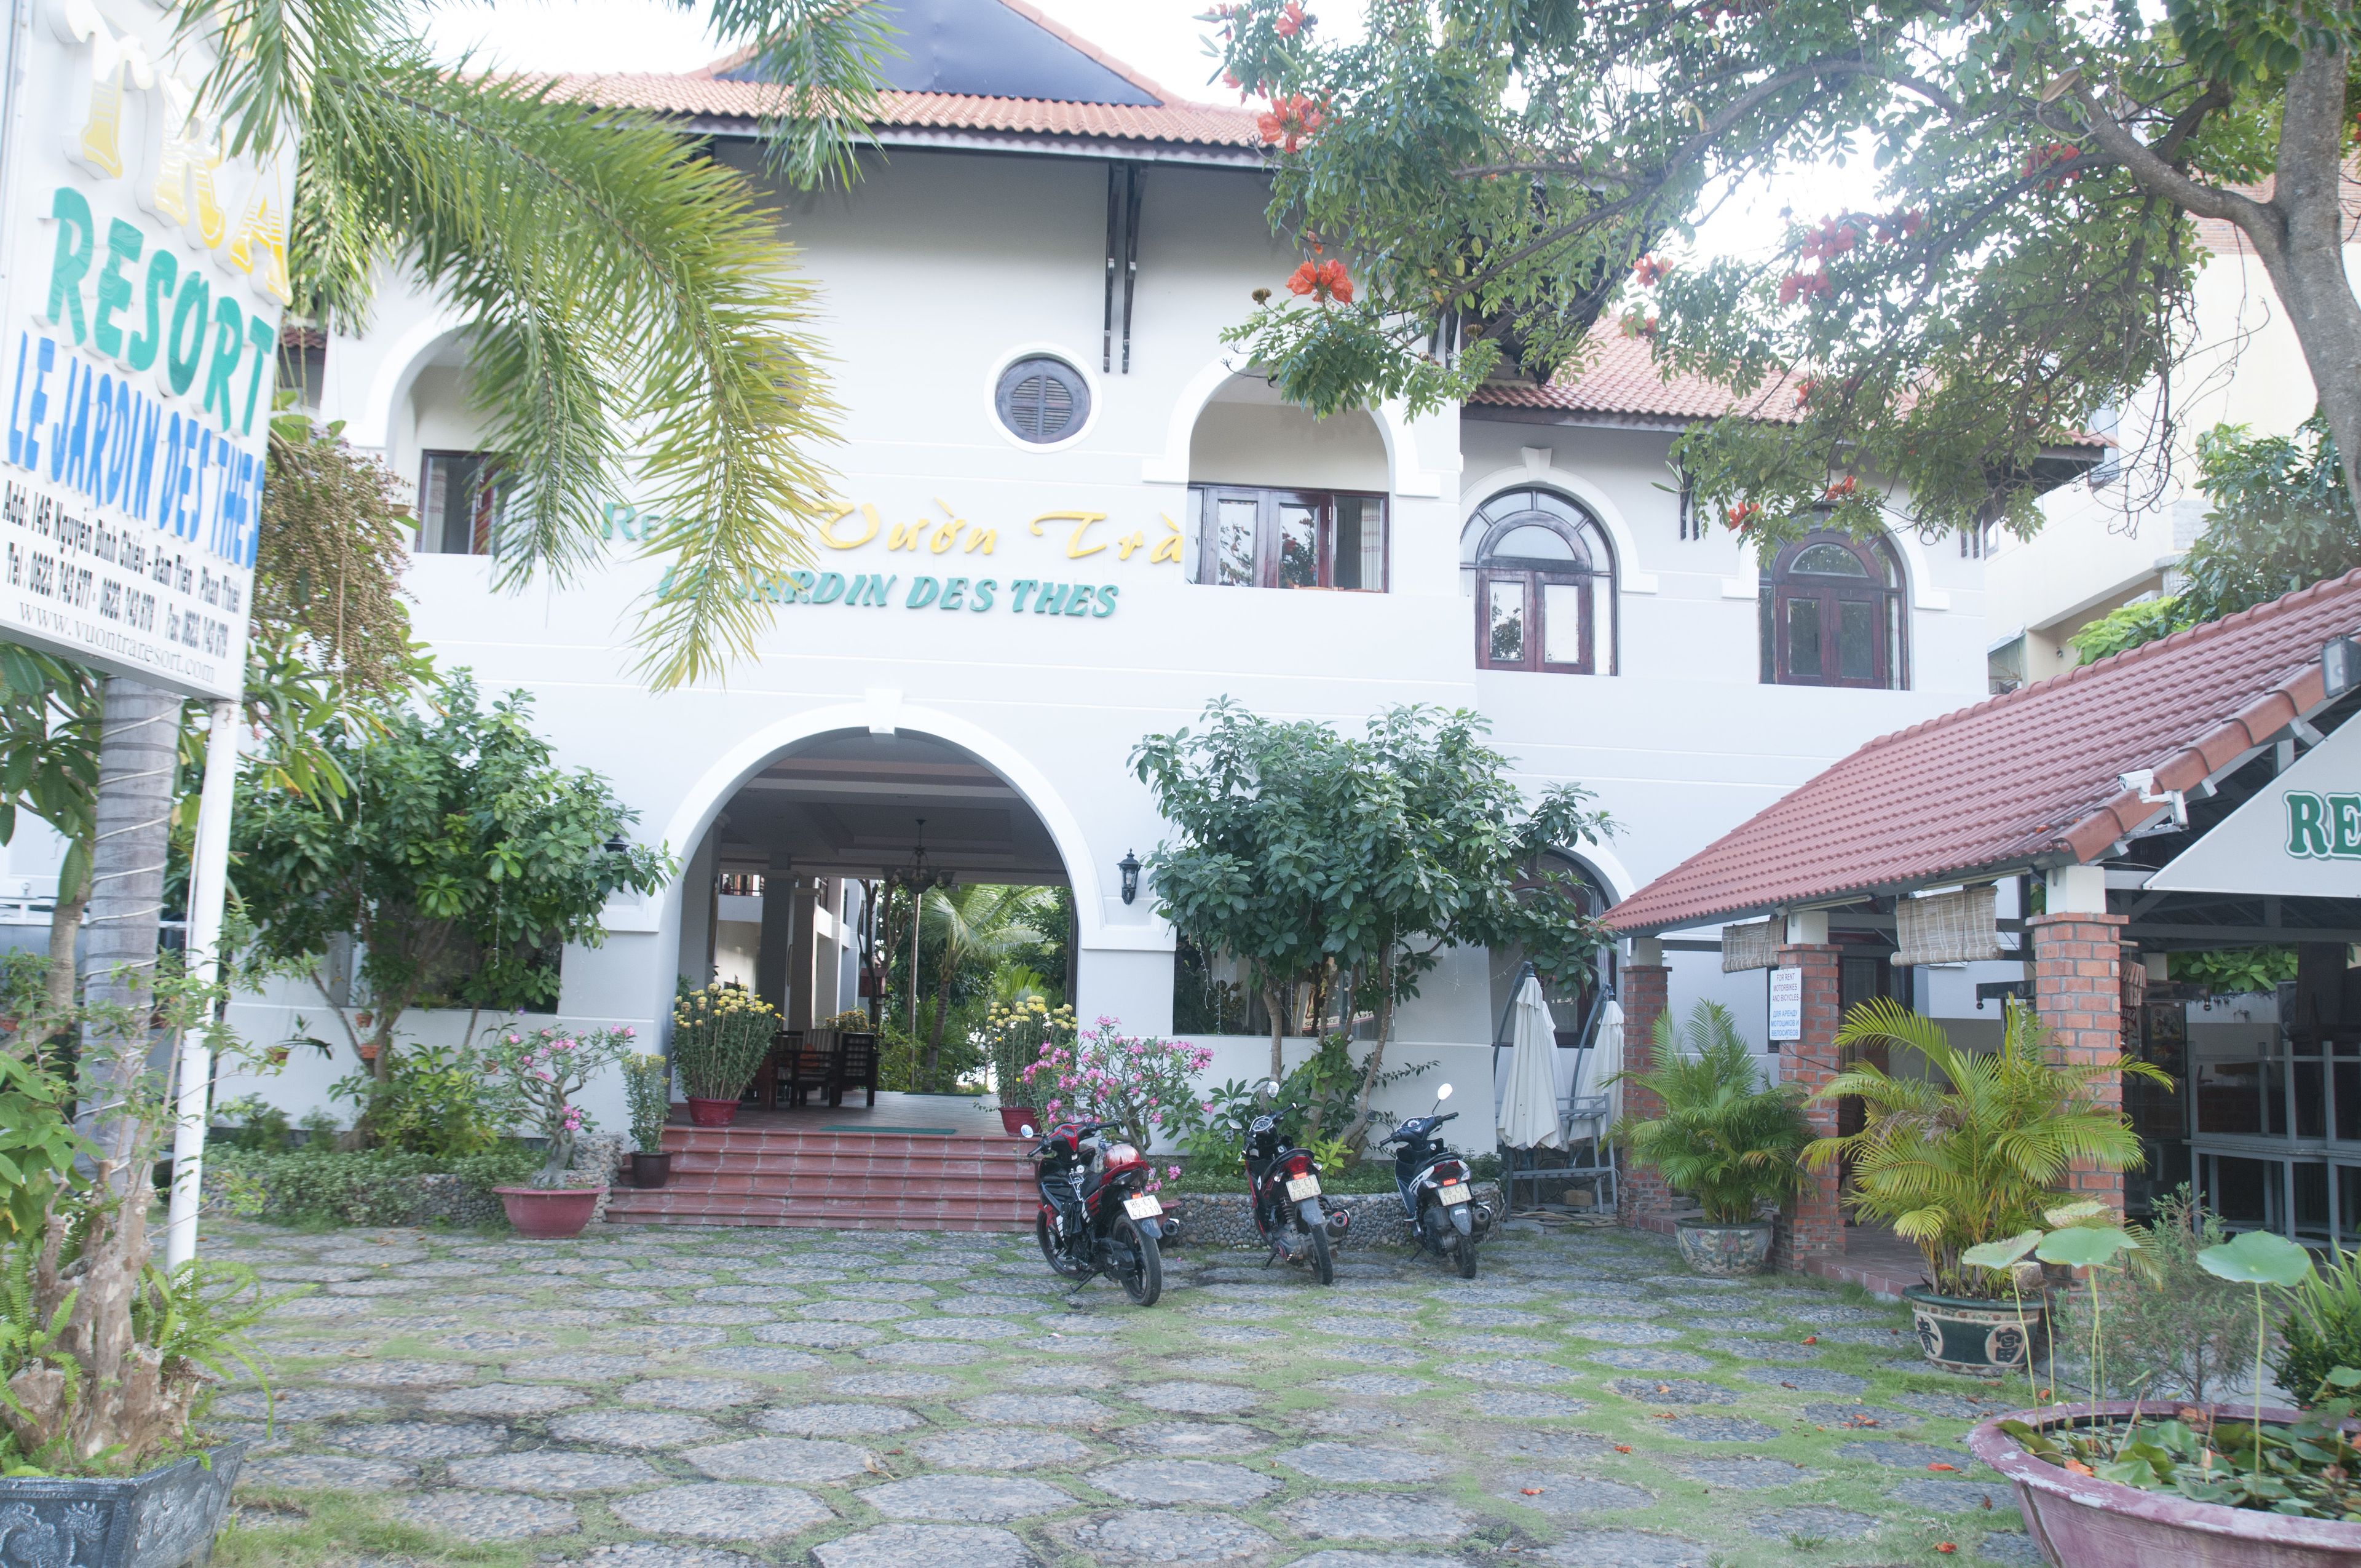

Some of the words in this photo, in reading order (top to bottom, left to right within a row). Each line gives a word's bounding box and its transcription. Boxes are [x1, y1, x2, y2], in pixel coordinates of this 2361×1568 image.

[47, 187, 275, 437] RESORT
[8, 330, 55, 472] LE
[52, 356, 161, 521] JARDIN
[159, 411, 211, 542] DES
[210, 437, 264, 569] THES
[2, 480, 28, 529] Add:
[31, 491, 52, 537] 146
[1029, 510, 1184, 564] Trà
[906, 576, 998, 612] DES
[1011, 579, 1120, 618] THES
[20, 602, 215, 684] www.vuontraresort.com
[1292, 1178, 1313, 1190] 86-C1
